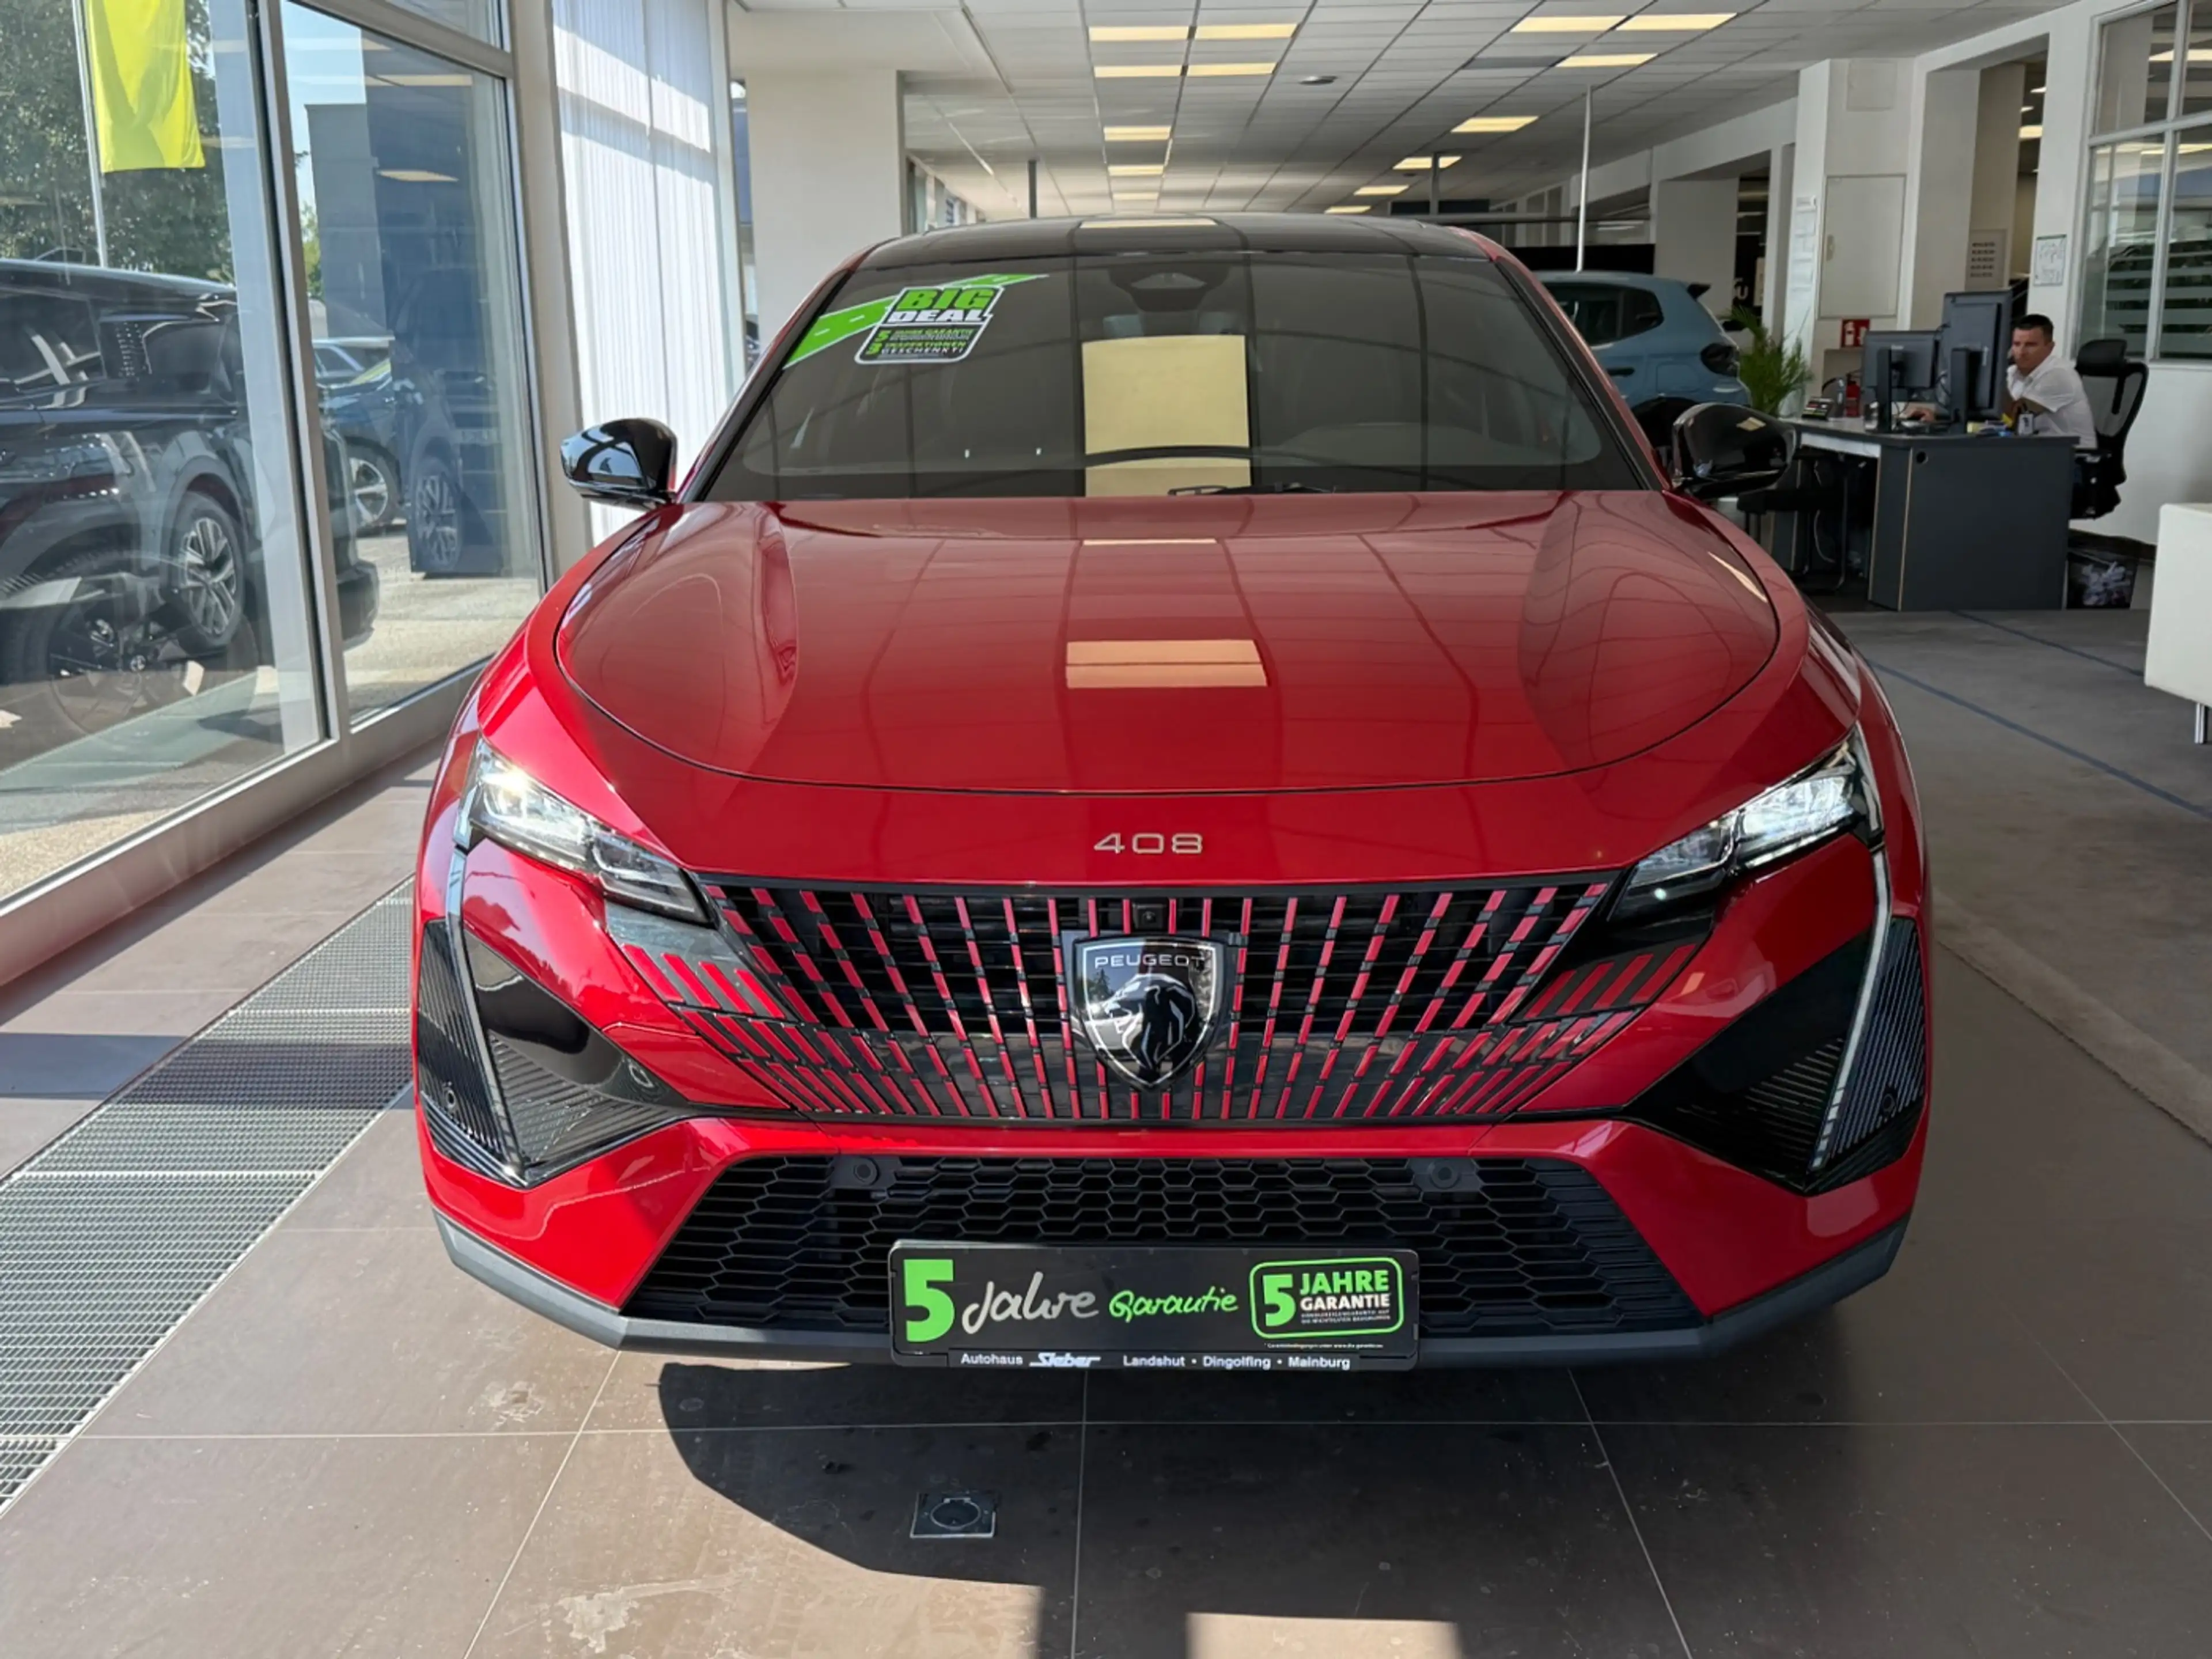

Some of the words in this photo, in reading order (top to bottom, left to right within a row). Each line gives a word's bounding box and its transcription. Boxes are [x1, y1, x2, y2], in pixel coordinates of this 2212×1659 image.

[896, 287, 994, 310] BIG
[888, 310, 986, 323] DEAL
[1094, 832, 1203, 854] 408
[1094, 955, 1205, 968] PEUGEOT
[904, 1259, 955, 1342] 5
[1263, 1274, 1296, 1327] 5
[1300, 1270, 1389, 1295] JAHRE
[1300, 1294, 1391, 1311] GARANTIE
[961, 1353, 1023, 1365] Autohaus
[1123, 1355, 1185, 1366] Landshut
[1202, 1355, 1271, 1369] Dingolfing
[1288, 1356, 1350, 1370] Mainburg
